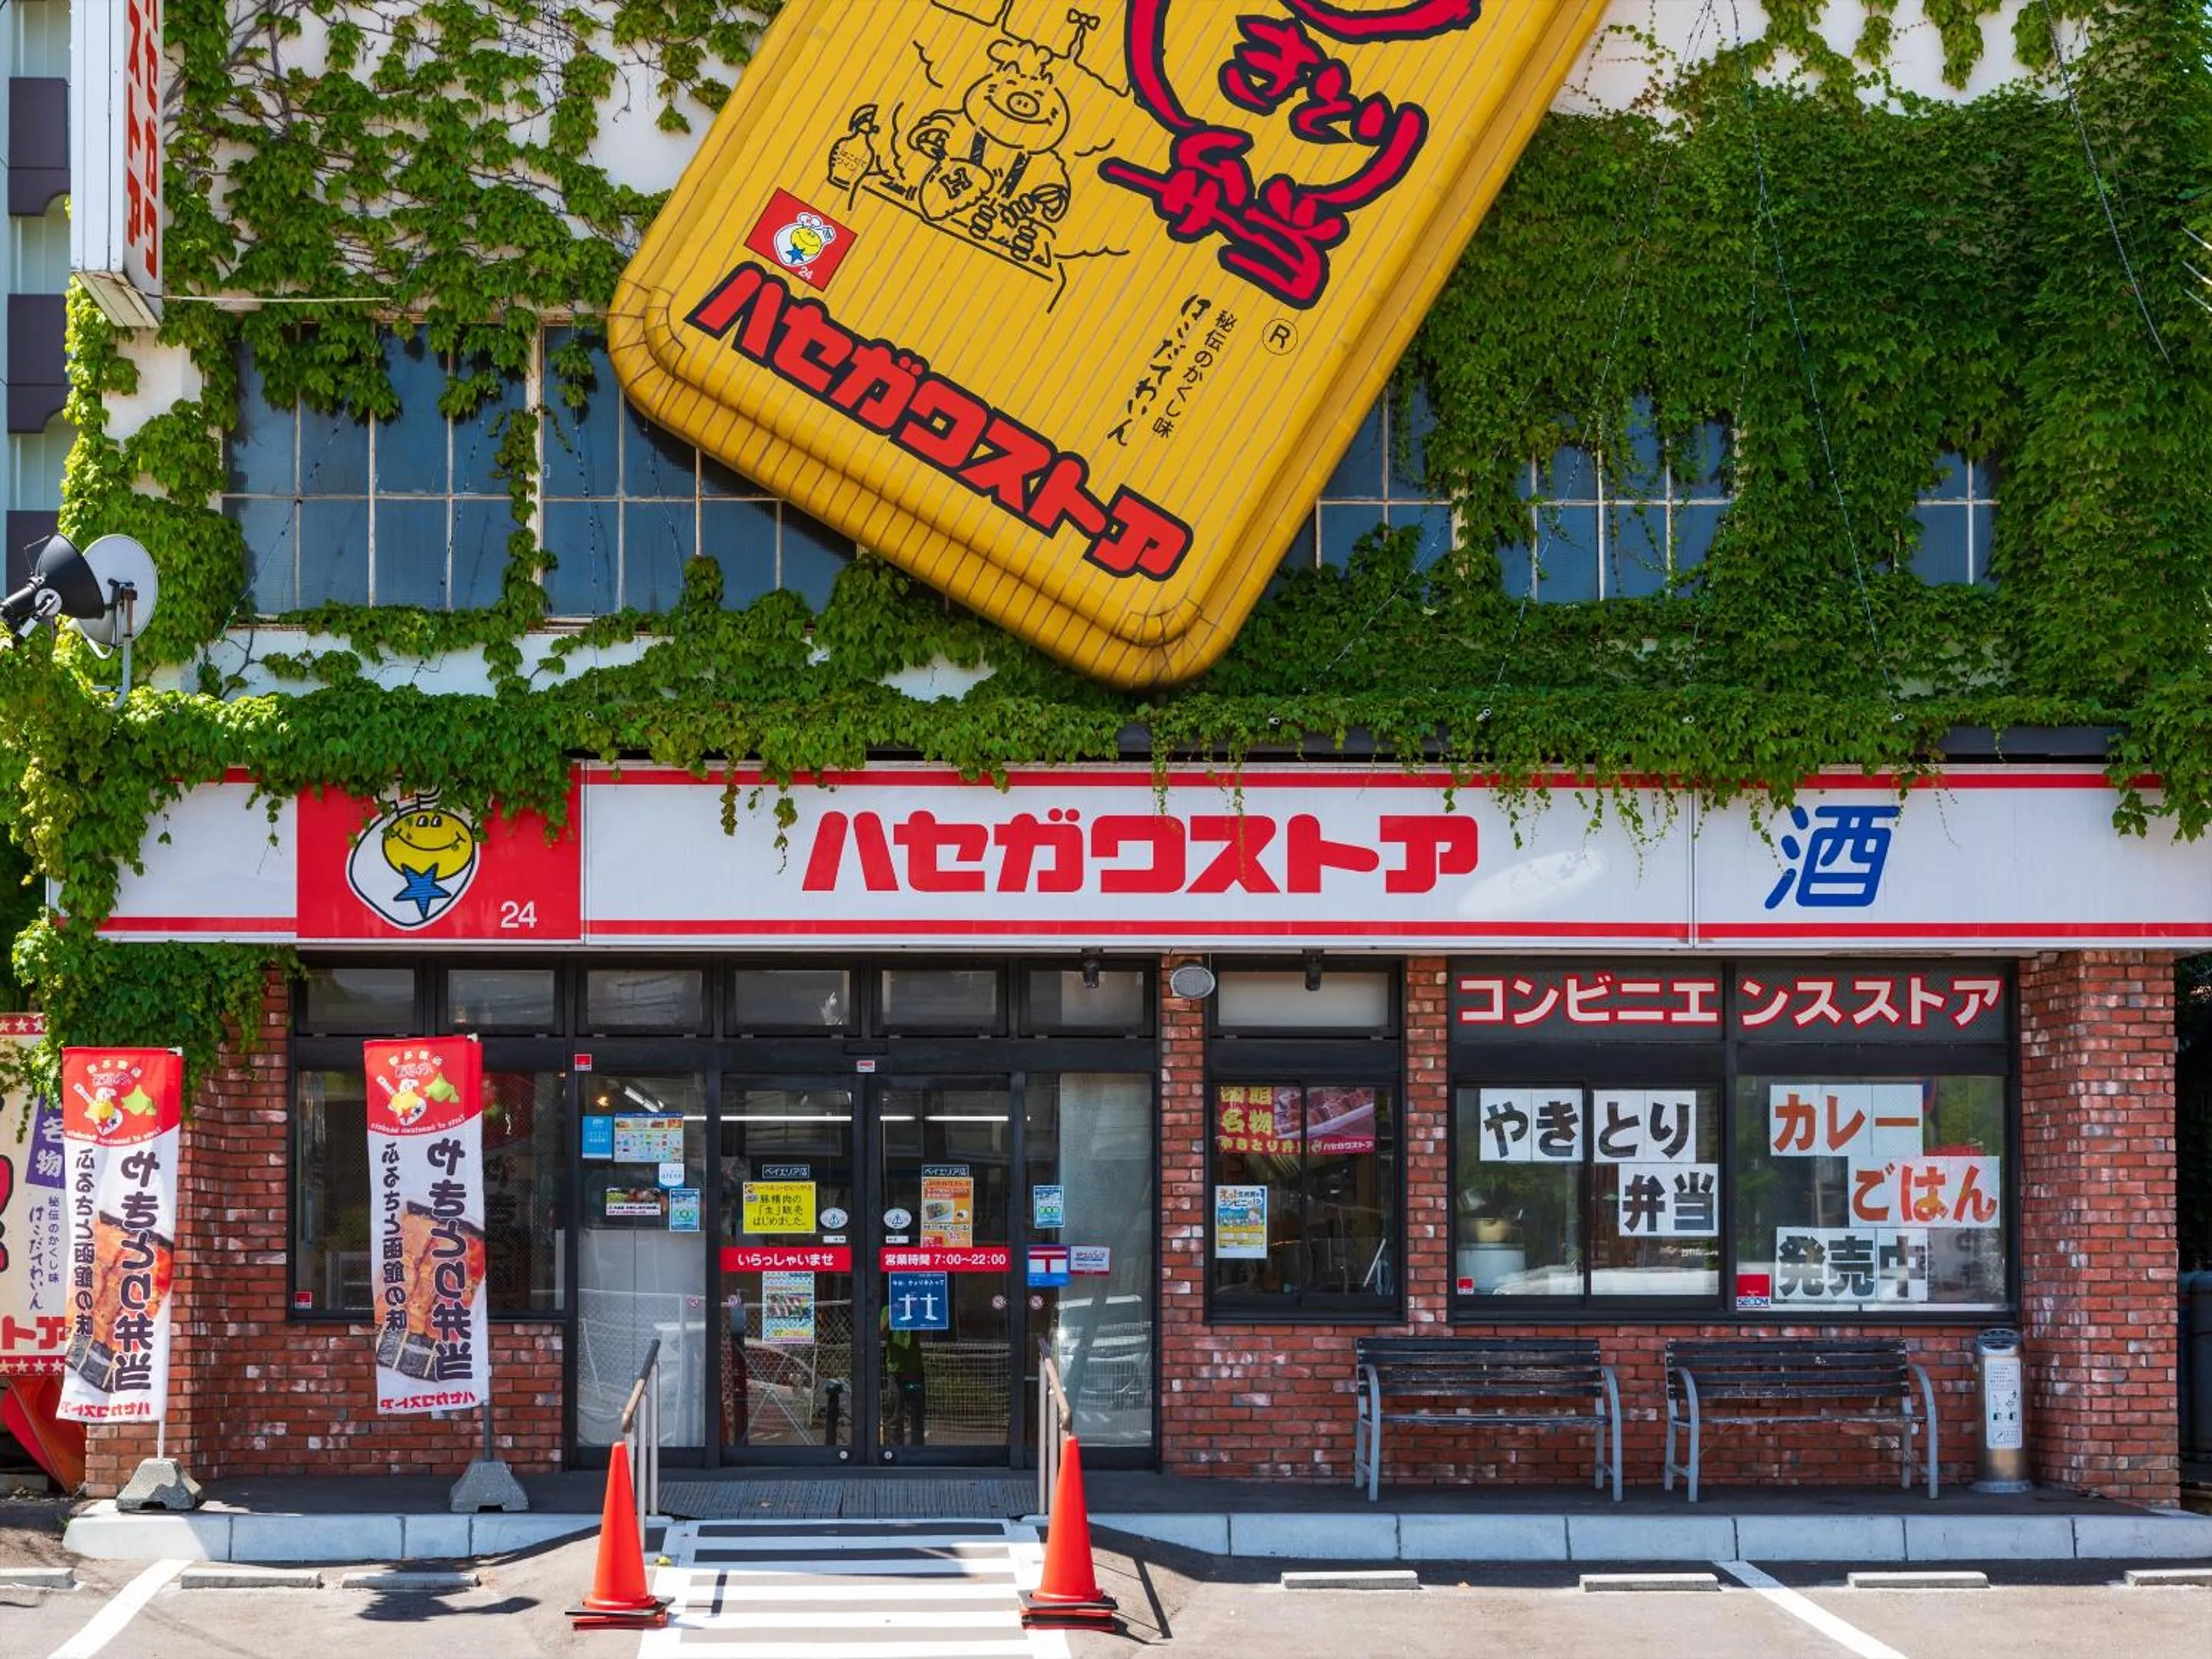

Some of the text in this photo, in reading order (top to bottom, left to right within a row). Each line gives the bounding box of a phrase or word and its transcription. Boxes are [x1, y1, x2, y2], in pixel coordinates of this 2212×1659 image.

[797, 265, 815, 282] 24
[1153, 310, 1238, 439] 秘伝のかくし味
[683, 260, 1194, 582] ハセガワストア
[802, 808, 1479, 892] ハセガワストア
[1765, 806, 1901, 909] 酒
[501, 901, 537, 929] 24
[1484, 1100, 1690, 1158] やきとり
[1773, 1093, 1919, 1151] カレー
[1623, 1172, 1714, 1233] 弁当
[1853, 1163, 1998, 1222] ごはん
[48, 1196, 60, 1283] 秘伝のかくし味
[737, 1253, 834, 1267] いらっしゃいませ
[885, 1253, 930, 1266] 営業時間
[1777, 1235, 1927, 1300] 発売中
